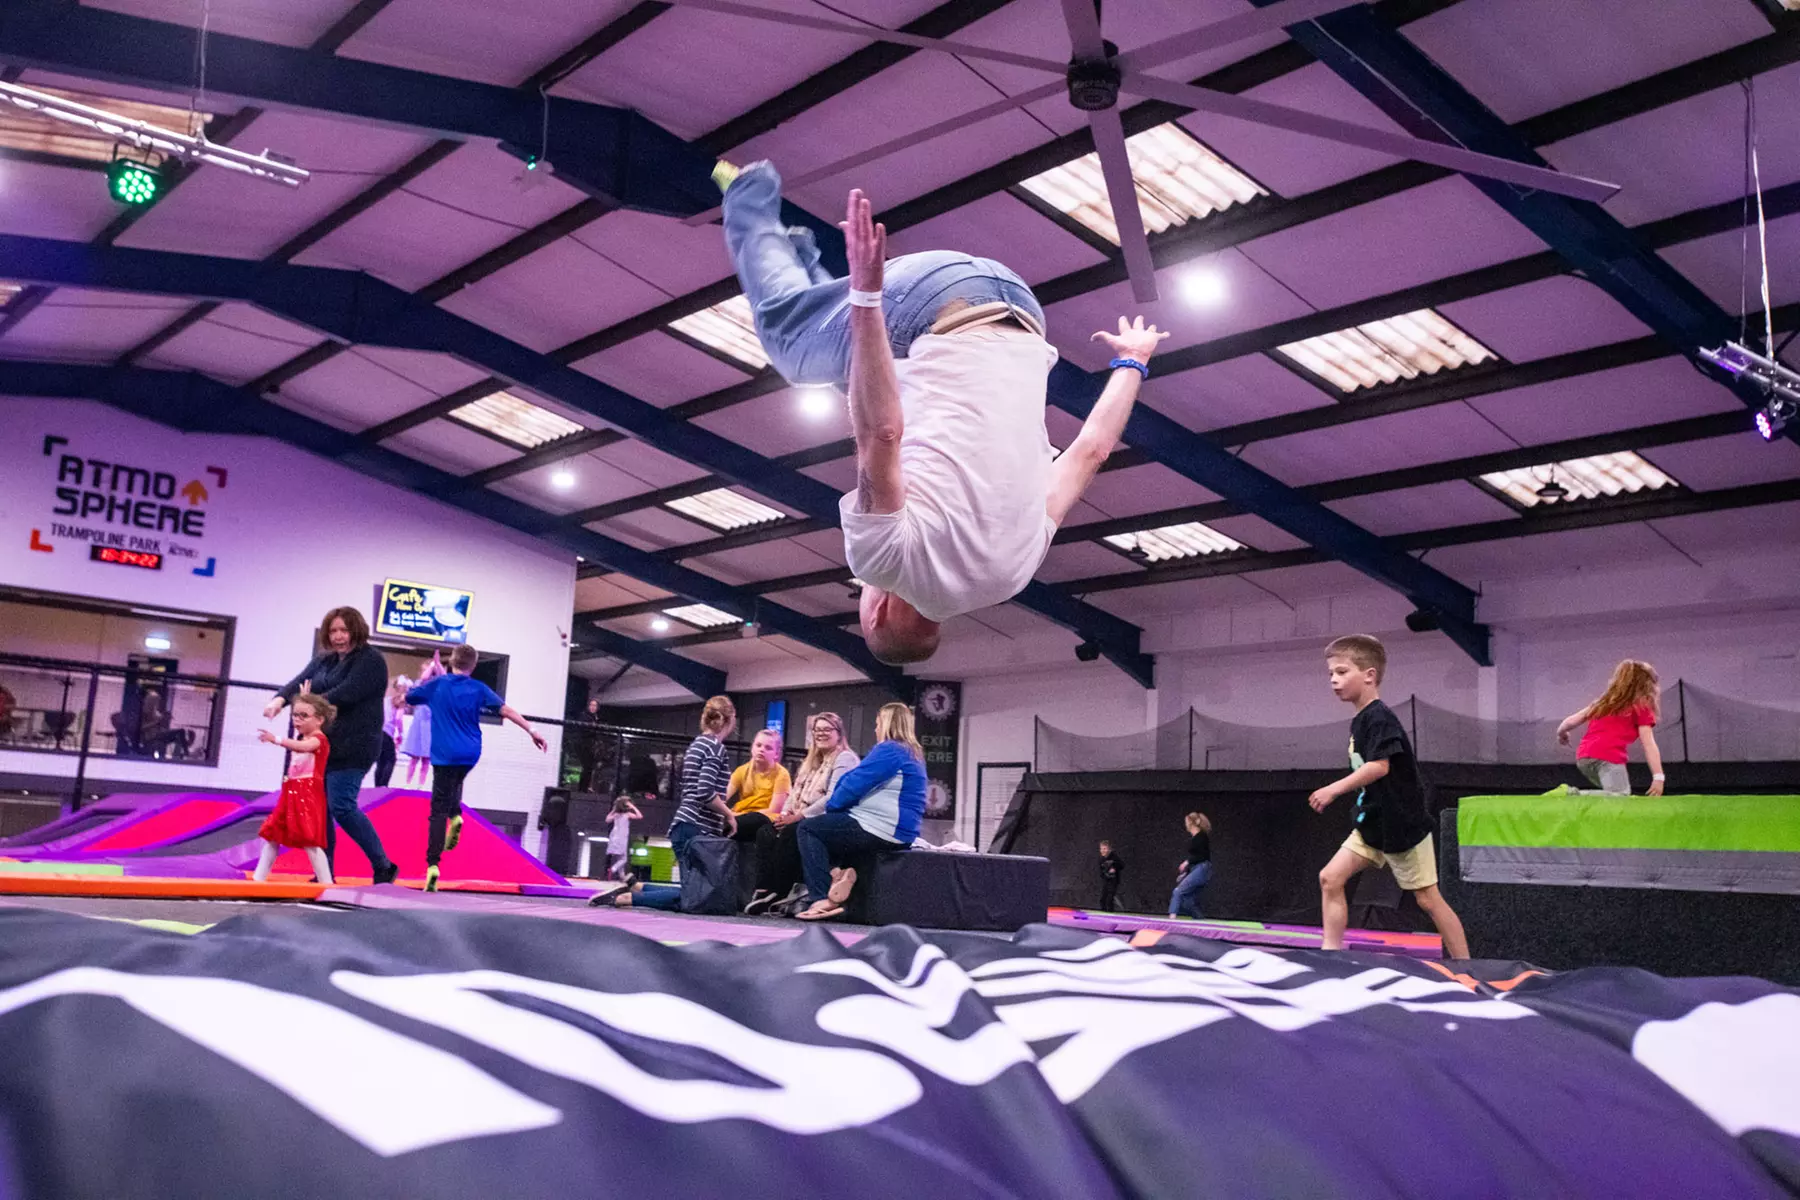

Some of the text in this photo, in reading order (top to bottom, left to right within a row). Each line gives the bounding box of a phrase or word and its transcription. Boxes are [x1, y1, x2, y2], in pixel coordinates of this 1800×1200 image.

[58, 454, 176, 500] ATMO
[52, 486, 206, 537] SPHERE
[51, 523, 161, 552] TRAMPOLINE PARK
[920, 735, 952, 747] EXIT
[926, 751, 953, 763] ERE
